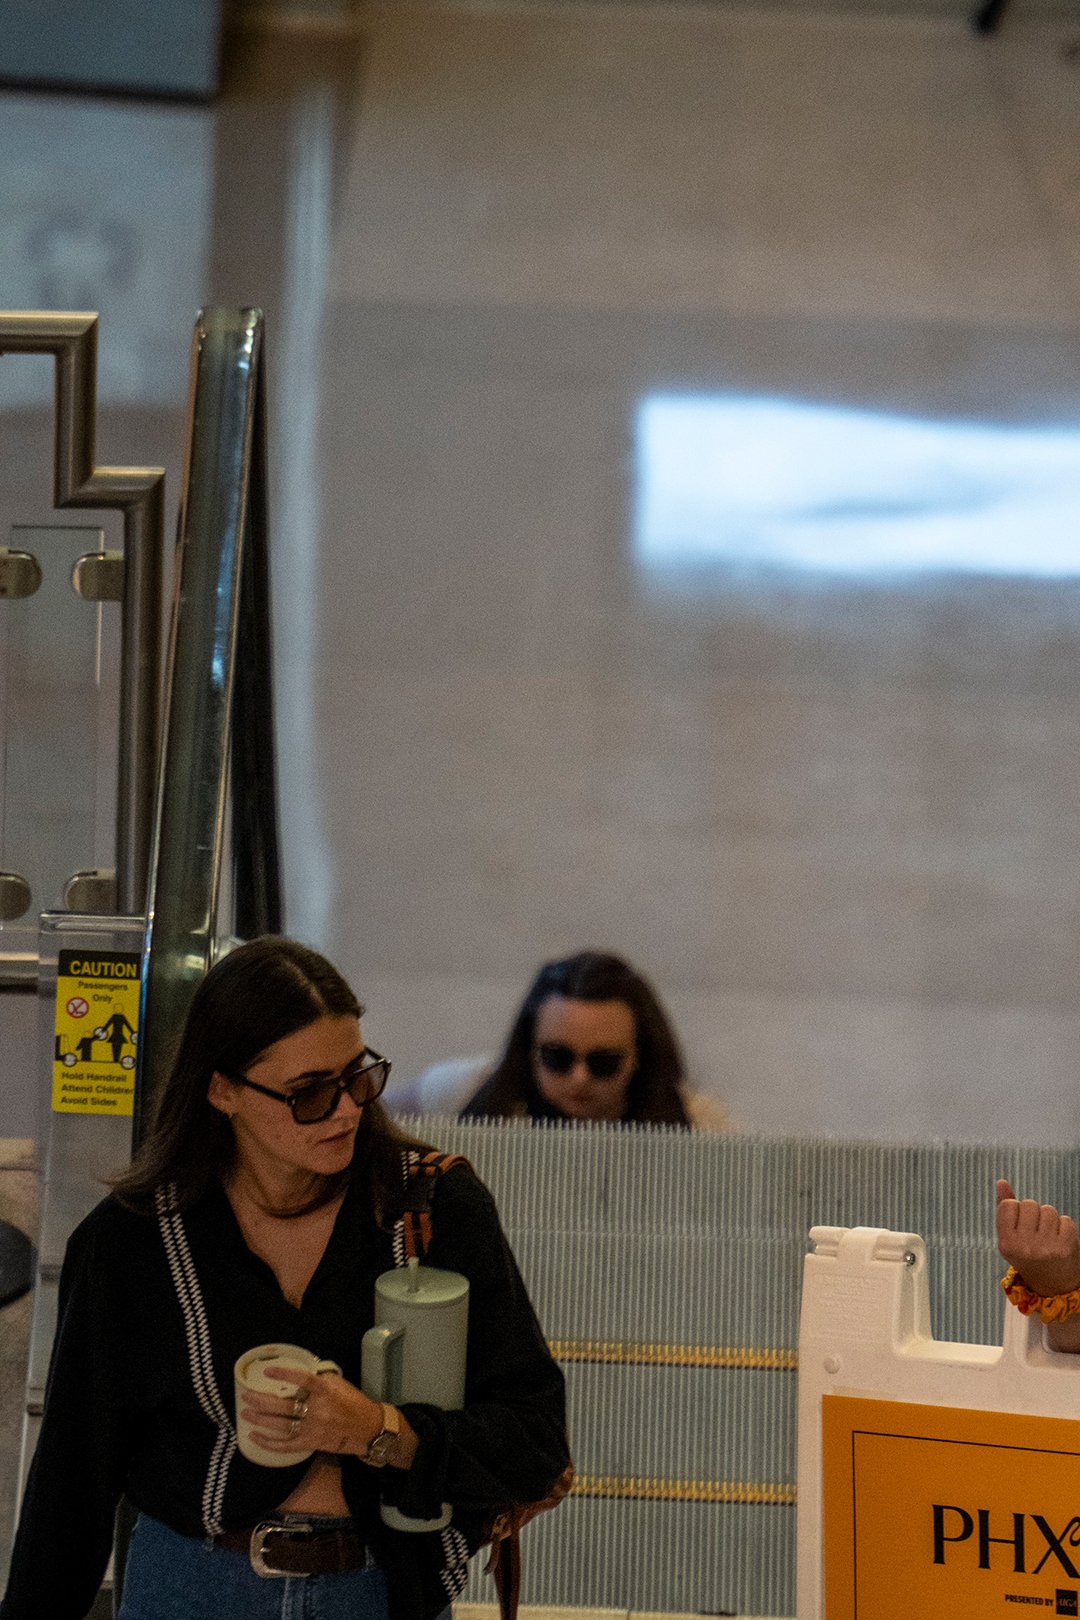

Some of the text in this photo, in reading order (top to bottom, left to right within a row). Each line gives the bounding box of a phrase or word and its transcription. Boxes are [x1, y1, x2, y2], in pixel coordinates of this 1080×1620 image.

[70, 960, 137, 977] CAUTION
[78, 981, 128, 992] Passengers
[92, 994, 113, 1004] Only
[61, 1072, 127, 1082] Hold Handrail
[61, 1084, 93, 1093] Attend
[60, 1096, 117, 1106] Avoid Sides
[1005, 1594, 1044, 1605] PRESENTED
[1045, 1598, 1053, 1606] BY
